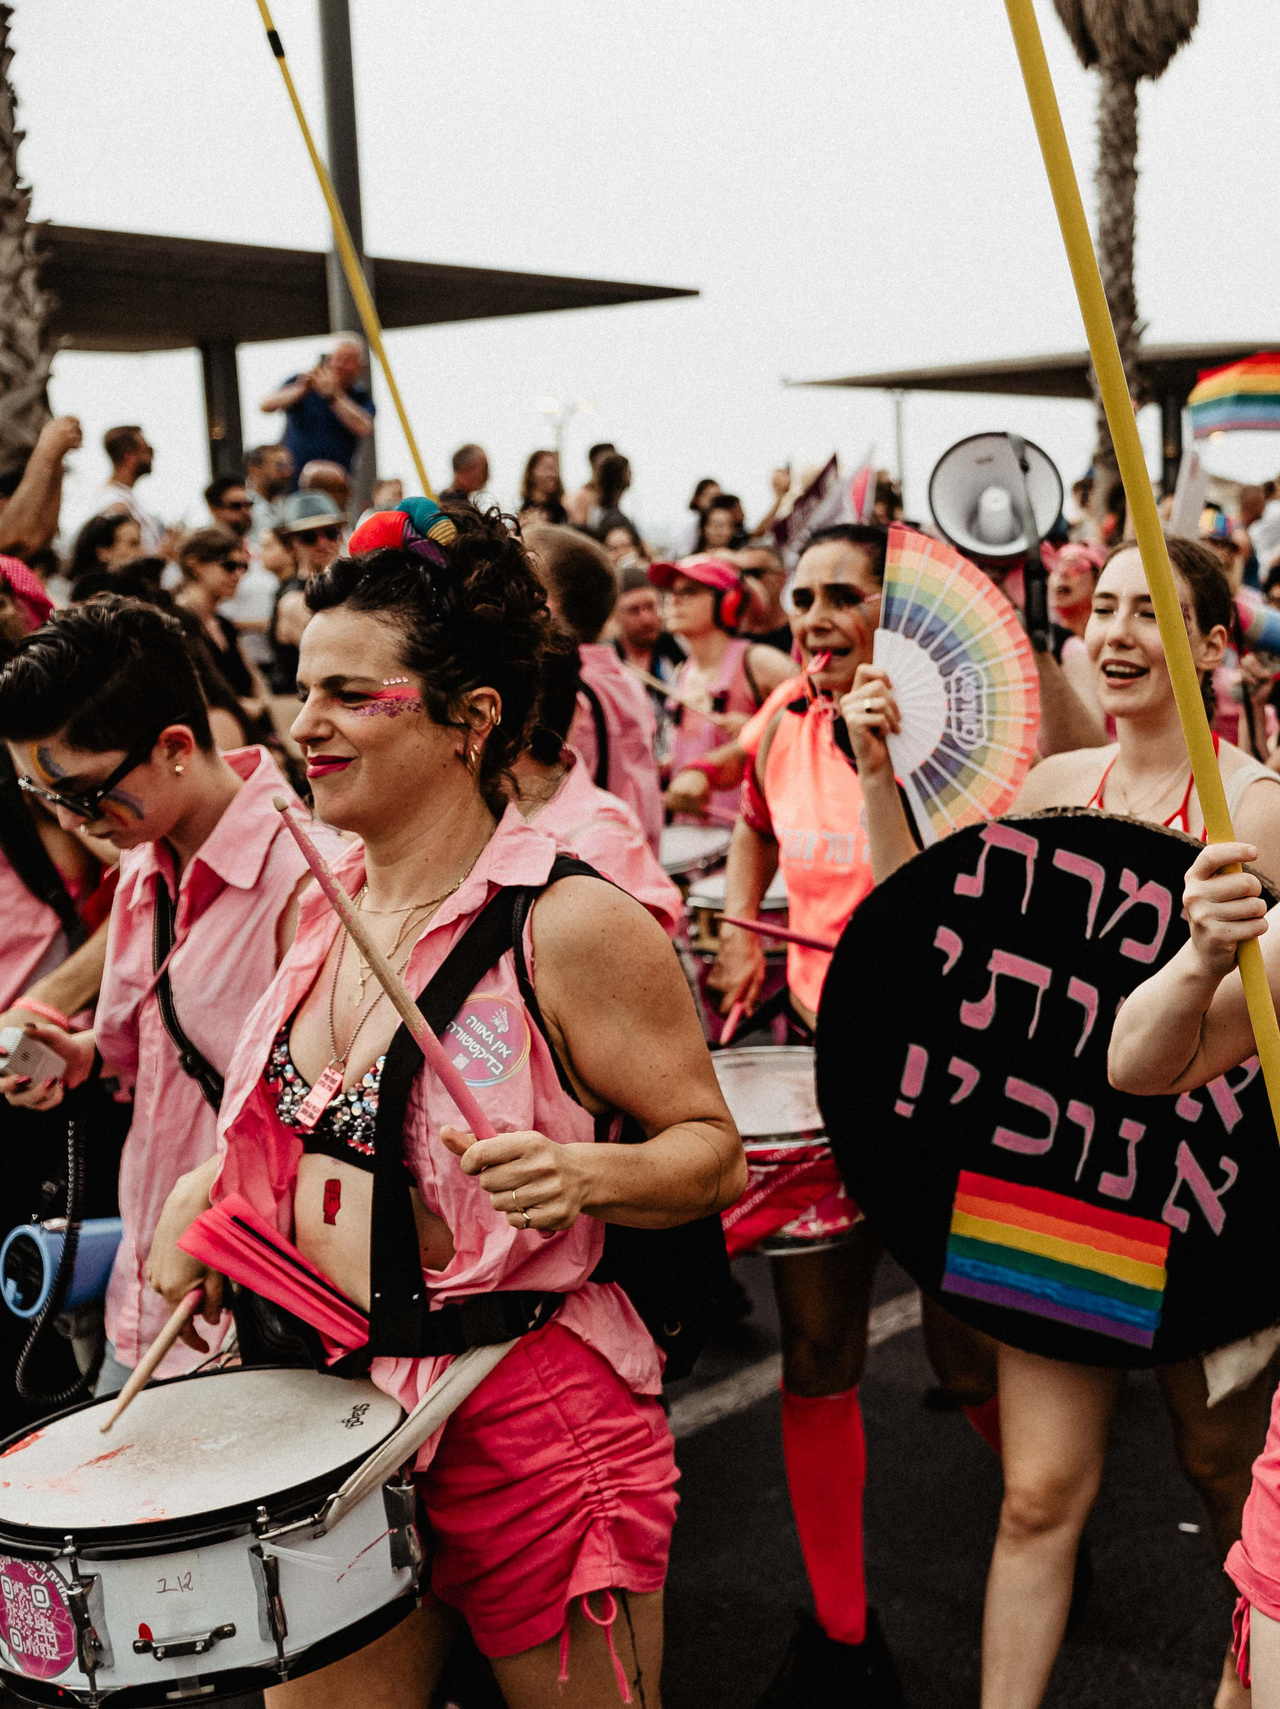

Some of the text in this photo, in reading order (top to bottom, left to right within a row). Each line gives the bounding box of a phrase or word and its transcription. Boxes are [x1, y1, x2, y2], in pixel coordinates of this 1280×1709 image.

[953, 822, 1190, 964] מרת
[466, 1015, 513, 1058] אין גאווה
[933, 925, 1261, 1134] אותי
[895, 1043, 1239, 1235] אנוכי!
